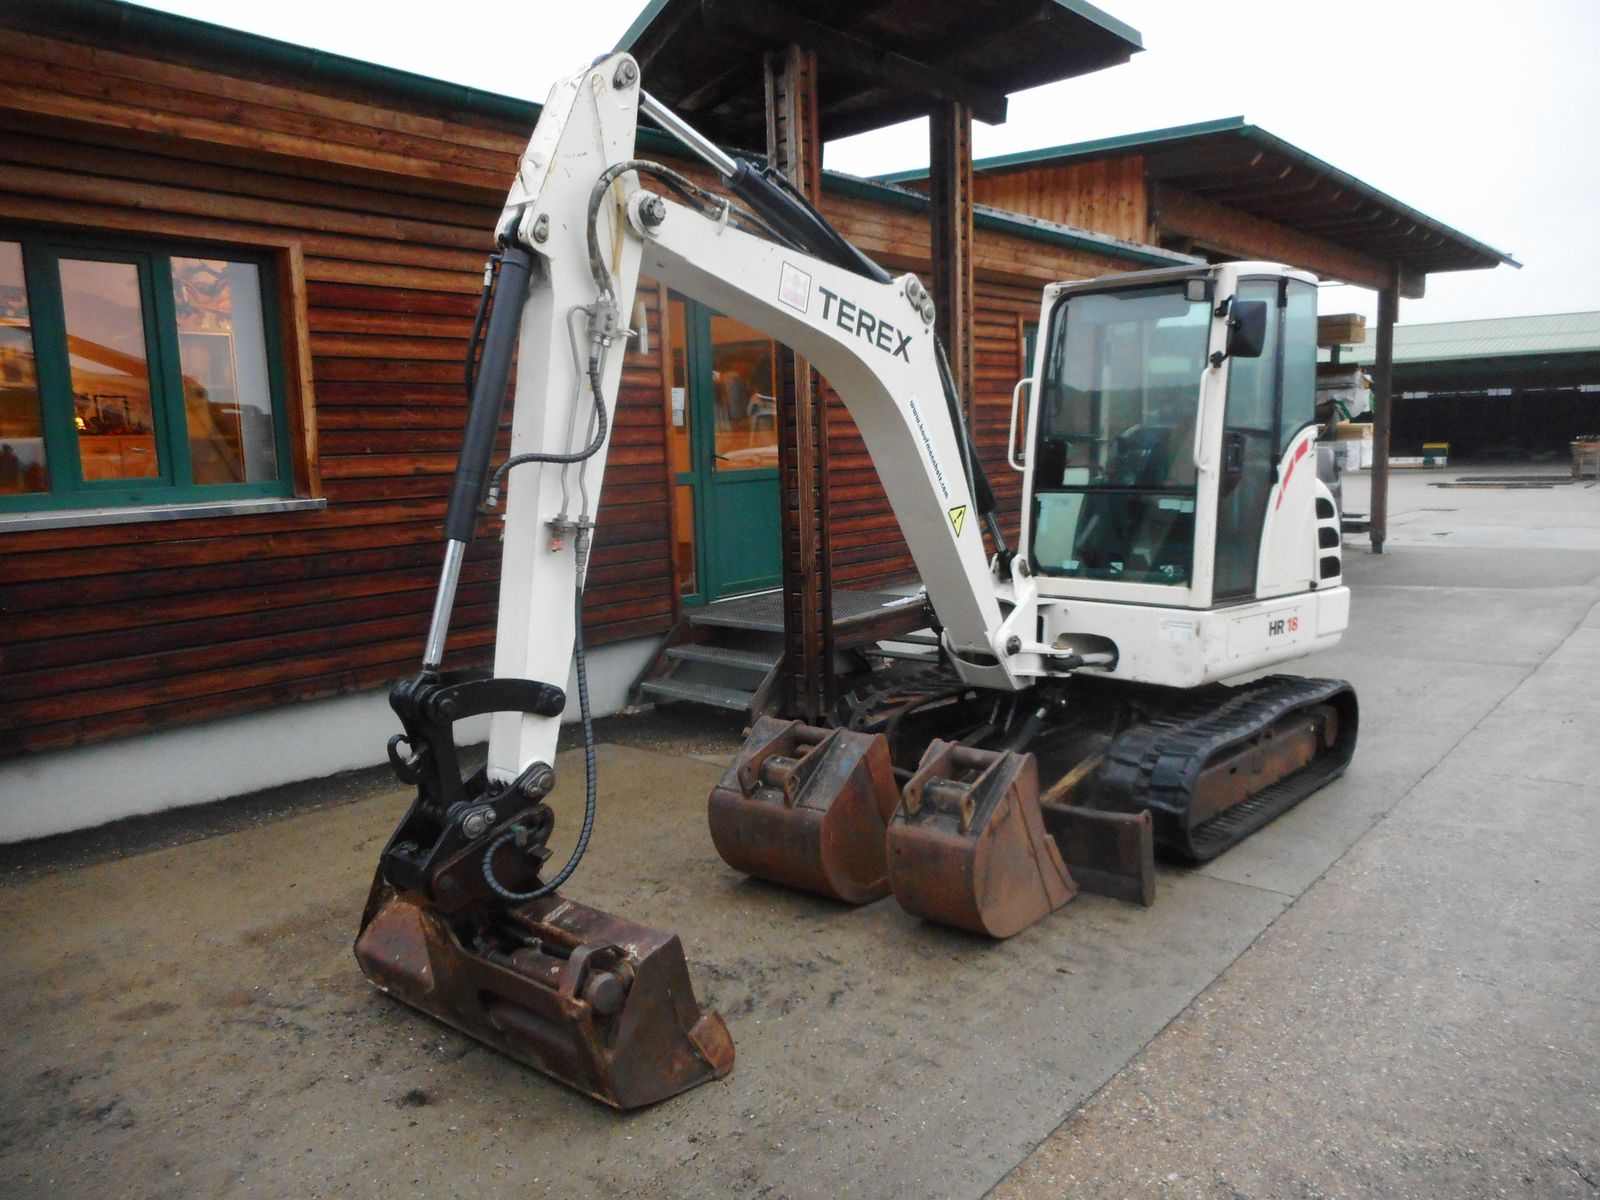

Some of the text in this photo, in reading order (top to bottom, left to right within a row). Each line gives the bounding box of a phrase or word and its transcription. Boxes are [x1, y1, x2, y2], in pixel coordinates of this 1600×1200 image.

[818, 285, 913, 364] TEREX
[1268, 617, 1298, 637] HR 18
